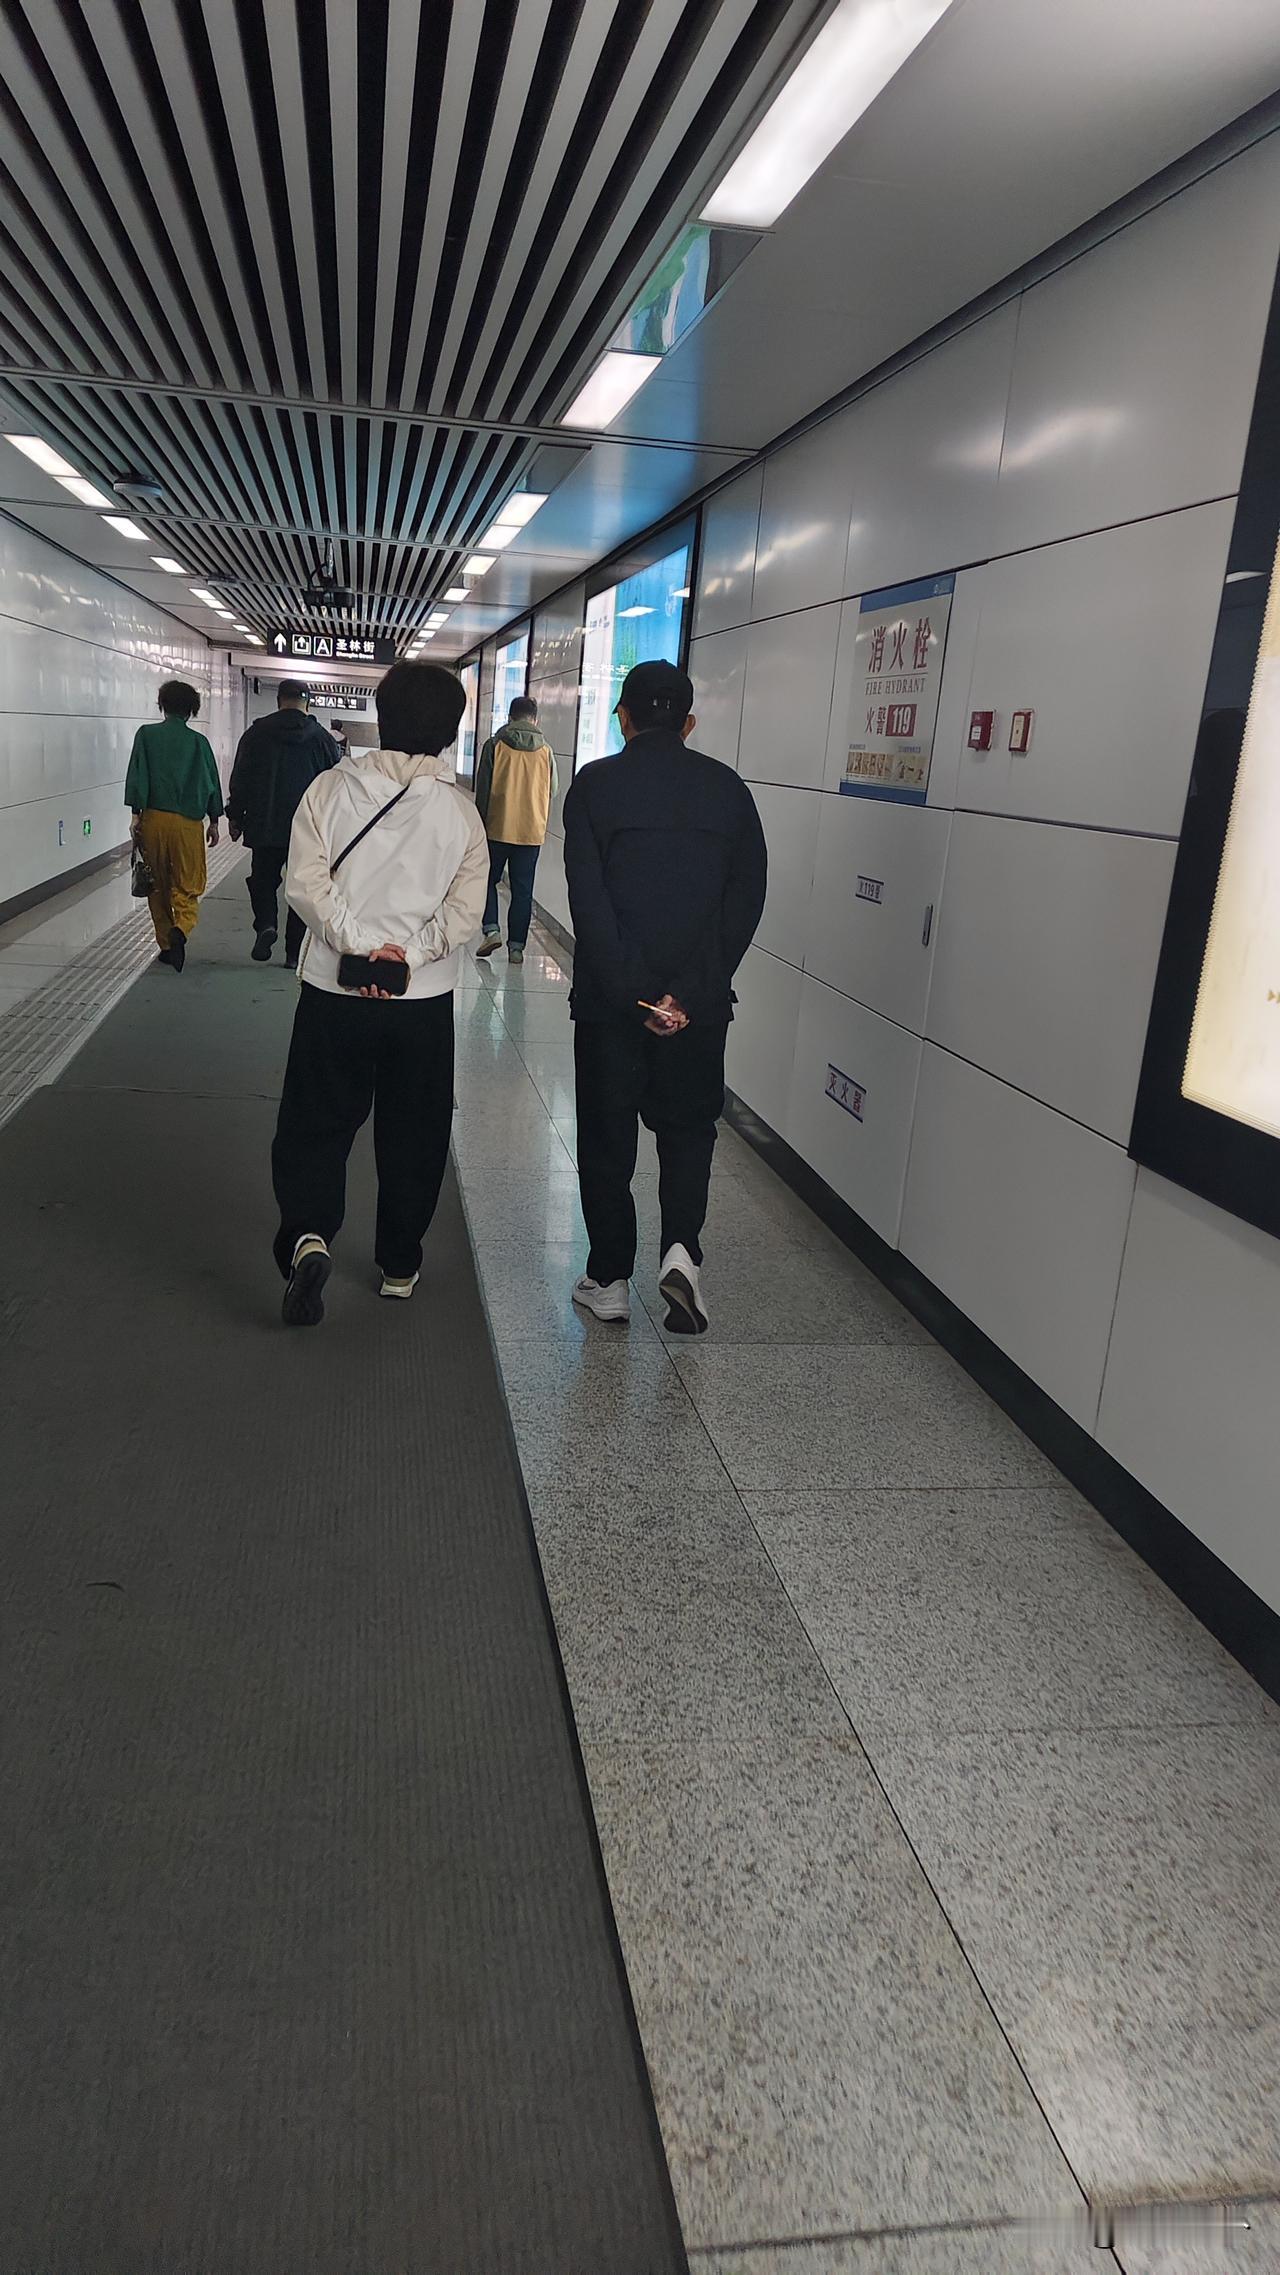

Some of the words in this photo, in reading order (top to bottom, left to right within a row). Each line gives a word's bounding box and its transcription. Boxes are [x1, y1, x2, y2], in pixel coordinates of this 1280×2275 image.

[316, 638, 330, 655] A
[336, 638, 375, 653] 圣林街
[868, 617, 931, 673] 消火栓
[865, 682, 882, 696] FIRE
[885, 678, 926, 694] HYDRANT
[865, 706, 887, 735] 火警
[892, 706, 912, 734] 119
